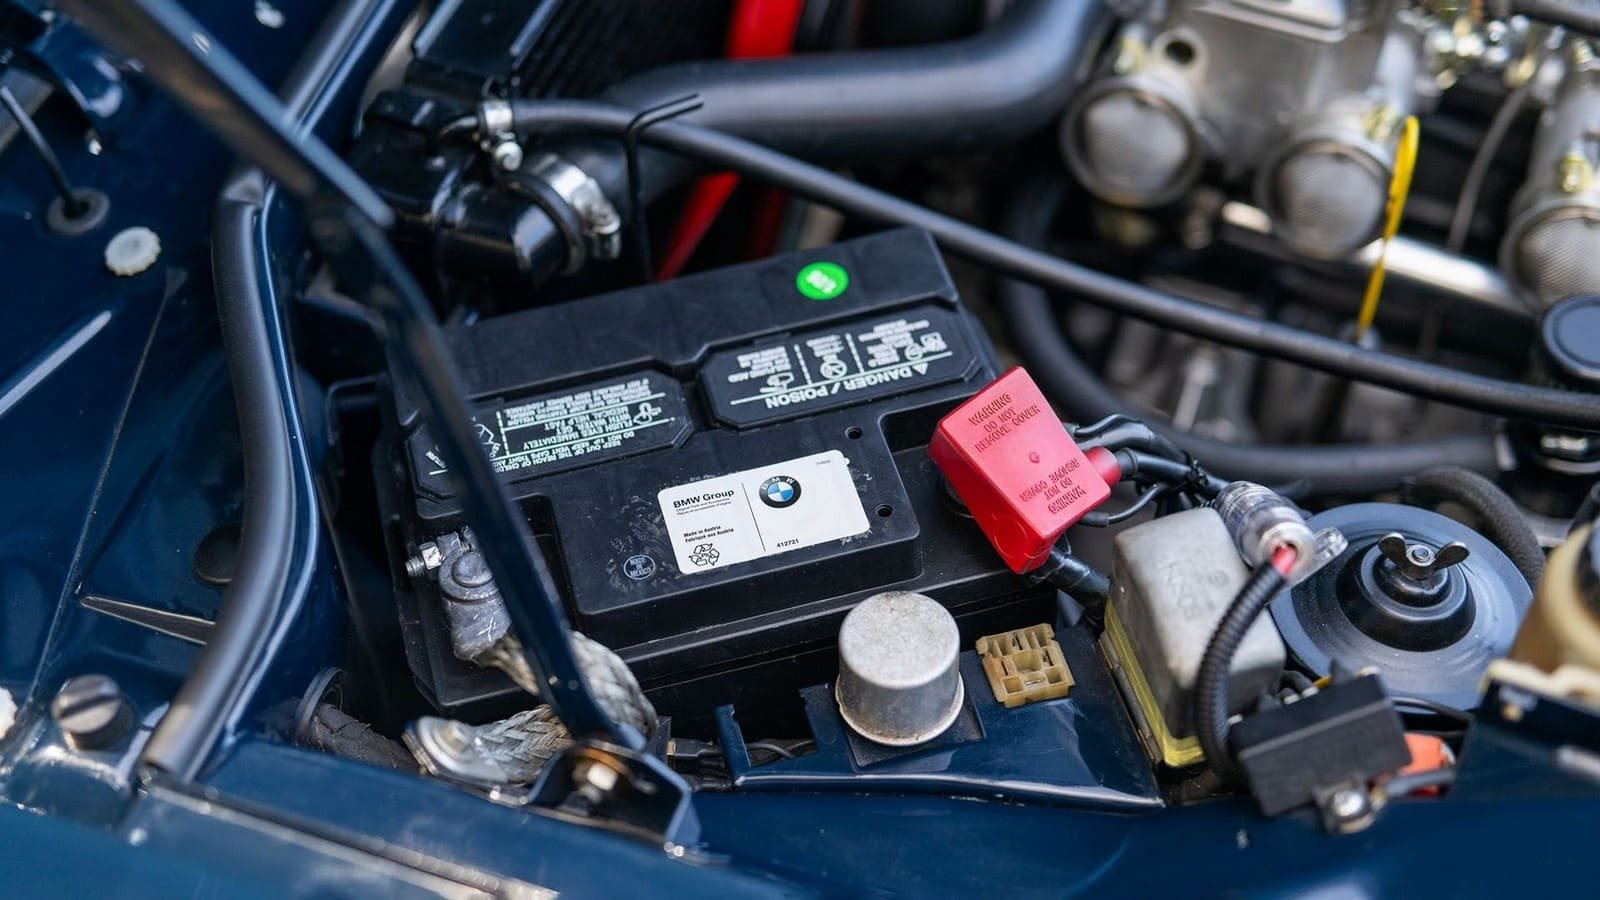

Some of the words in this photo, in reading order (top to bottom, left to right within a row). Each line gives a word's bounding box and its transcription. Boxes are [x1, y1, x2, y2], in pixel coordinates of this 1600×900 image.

[842, 365, 913, 392] DANGER
[764, 384, 828, 409] POISON
[591, 405, 629, 420] MEDICAL
[607, 411, 631, 423] WITH
[968, 392, 1012, 426] WARNING
[542, 419, 565, 430] FAST
[565, 413, 590, 425] HELP
[604, 418, 632, 431] FLUSH
[983, 420, 998, 433] DO
[998, 406, 1017, 423] NOT
[974, 424, 1012, 453] REMOVE
[1011, 405, 1041, 426] COVER
[521, 430, 579, 450] IMMEDIATELY
[1048, 457, 1081, 484] REMOVE
[1019, 479, 1048, 502] COVER
[1060, 476, 1073, 489] DO
[673, 495, 701, 508] BMW
[702, 489, 735, 502] Group
[1043, 484, 1061, 501] NOT
[1048, 484, 1087, 515] WARNING
[704, 525, 721, 533] Austria
[776, 538, 800, 549] 412721
